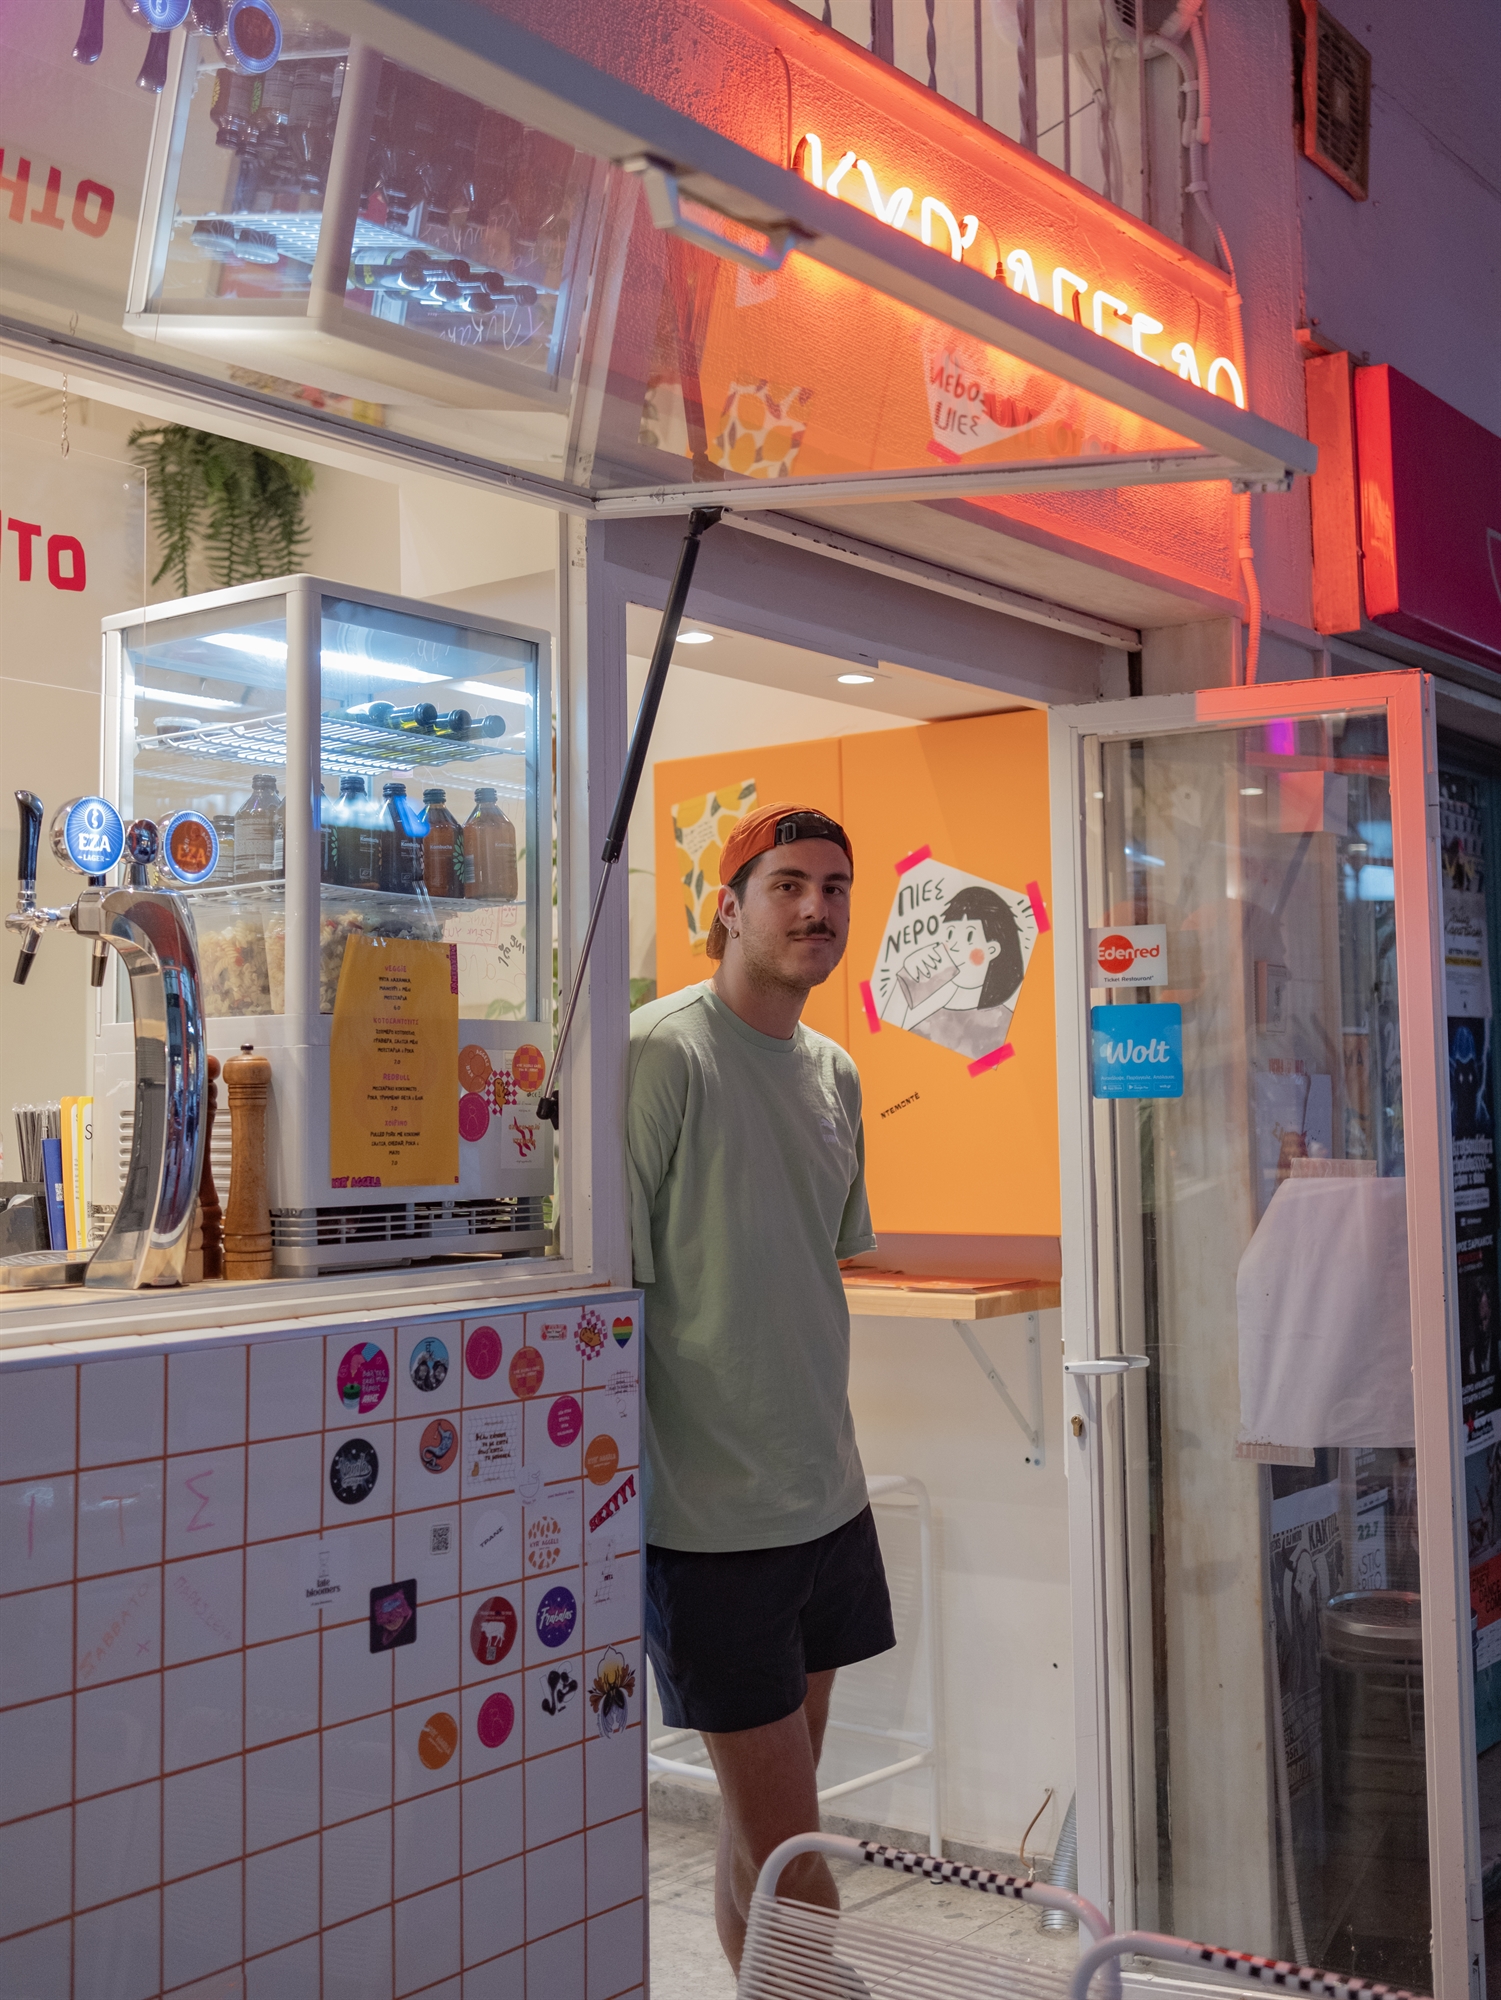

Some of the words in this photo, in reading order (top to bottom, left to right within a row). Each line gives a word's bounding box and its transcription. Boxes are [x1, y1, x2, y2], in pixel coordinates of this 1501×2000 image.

[0, 510, 86, 592] ΤΟ
[78, 833, 111, 853] EZA
[83, 854, 105, 862] LAGER
[898, 877, 945, 917] ΠΙΕΣ
[884, 915, 939, 962] ΝΕΡΟ
[1097, 944, 1161, 961] Edenred
[1106, 1038, 1170, 1064] Wolt
[588, 1473, 637, 1533] SEXYYY
[1357, 1520, 1379, 1542] 22.7
[306, 1585, 341, 1598] bloomers
[317, 1578, 331, 1588] late
